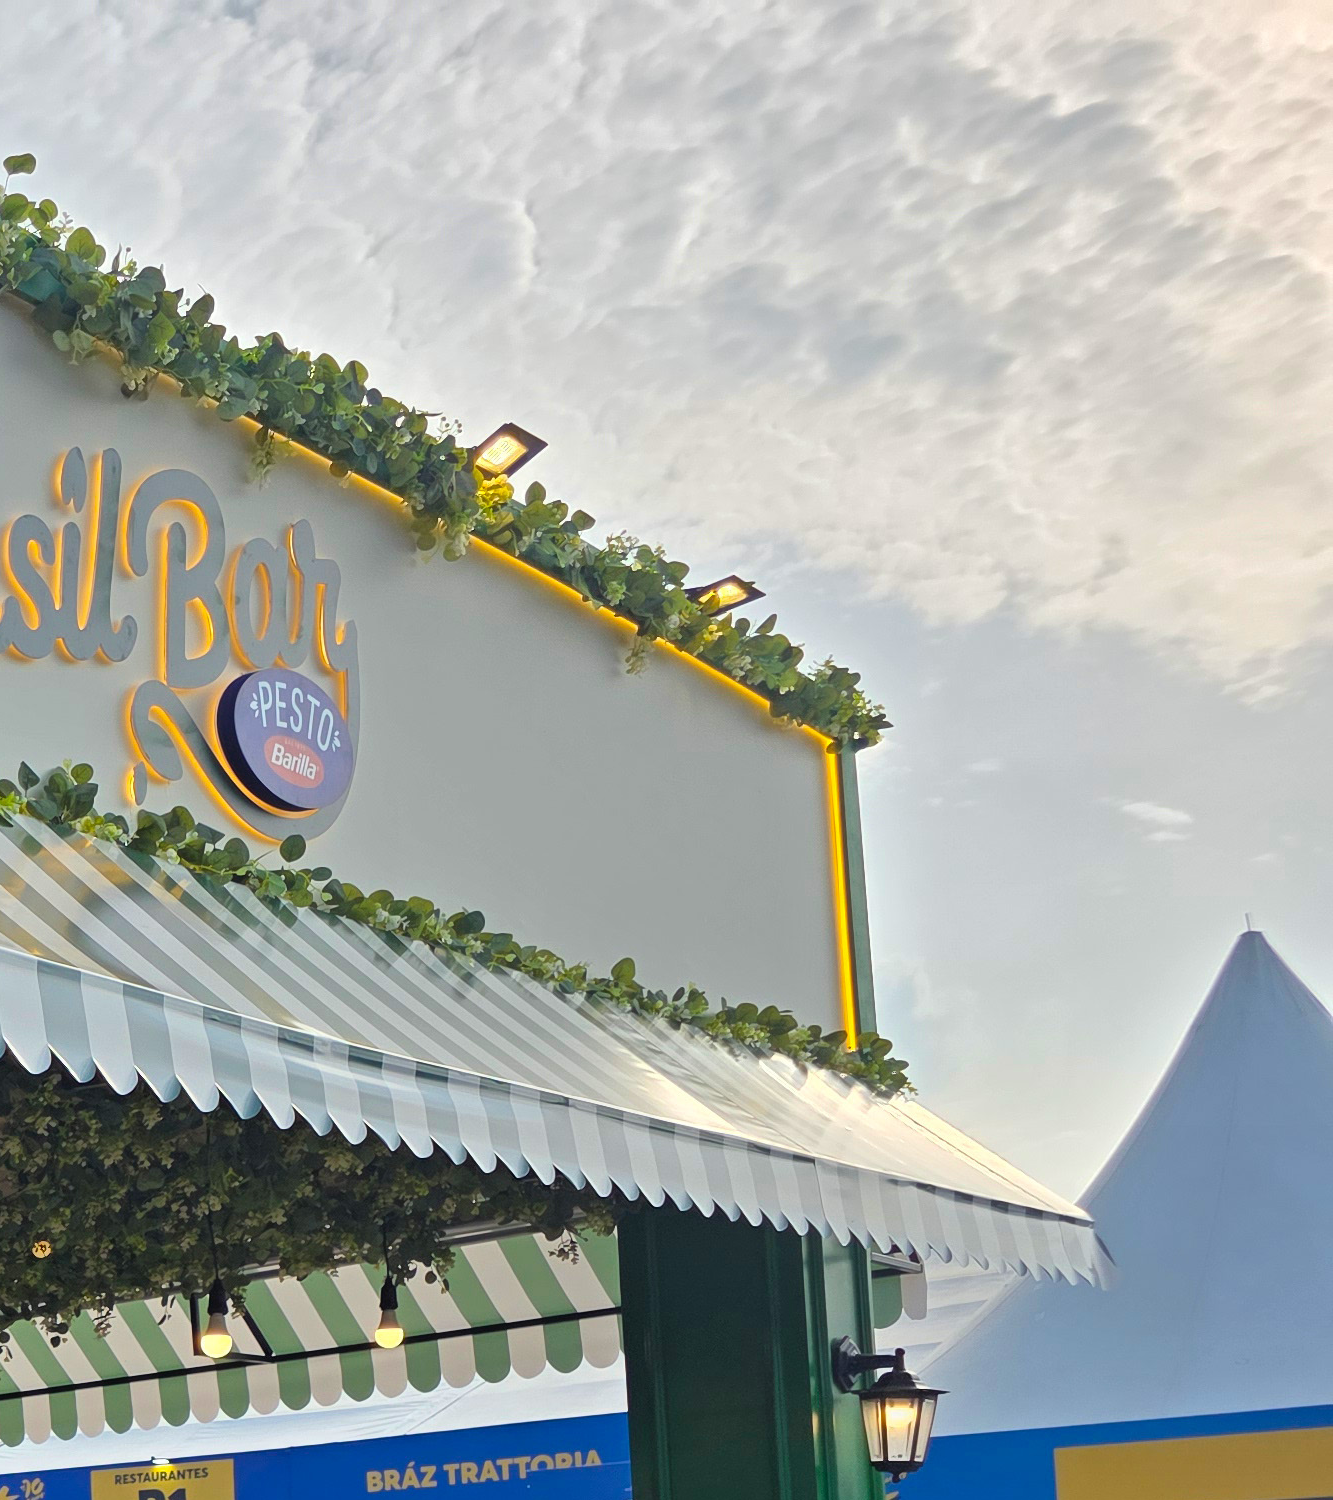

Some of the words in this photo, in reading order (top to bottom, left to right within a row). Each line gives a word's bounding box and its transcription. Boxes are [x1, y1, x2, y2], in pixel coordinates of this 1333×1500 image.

[127, 469, 358, 700] Bar
[258, 681, 334, 752] PESTO
[271, 743, 318, 780] Barilla
[114, 1467, 209, 1486] RESTAURANTES
[366, 1460, 438, 1493] BRÁZ
